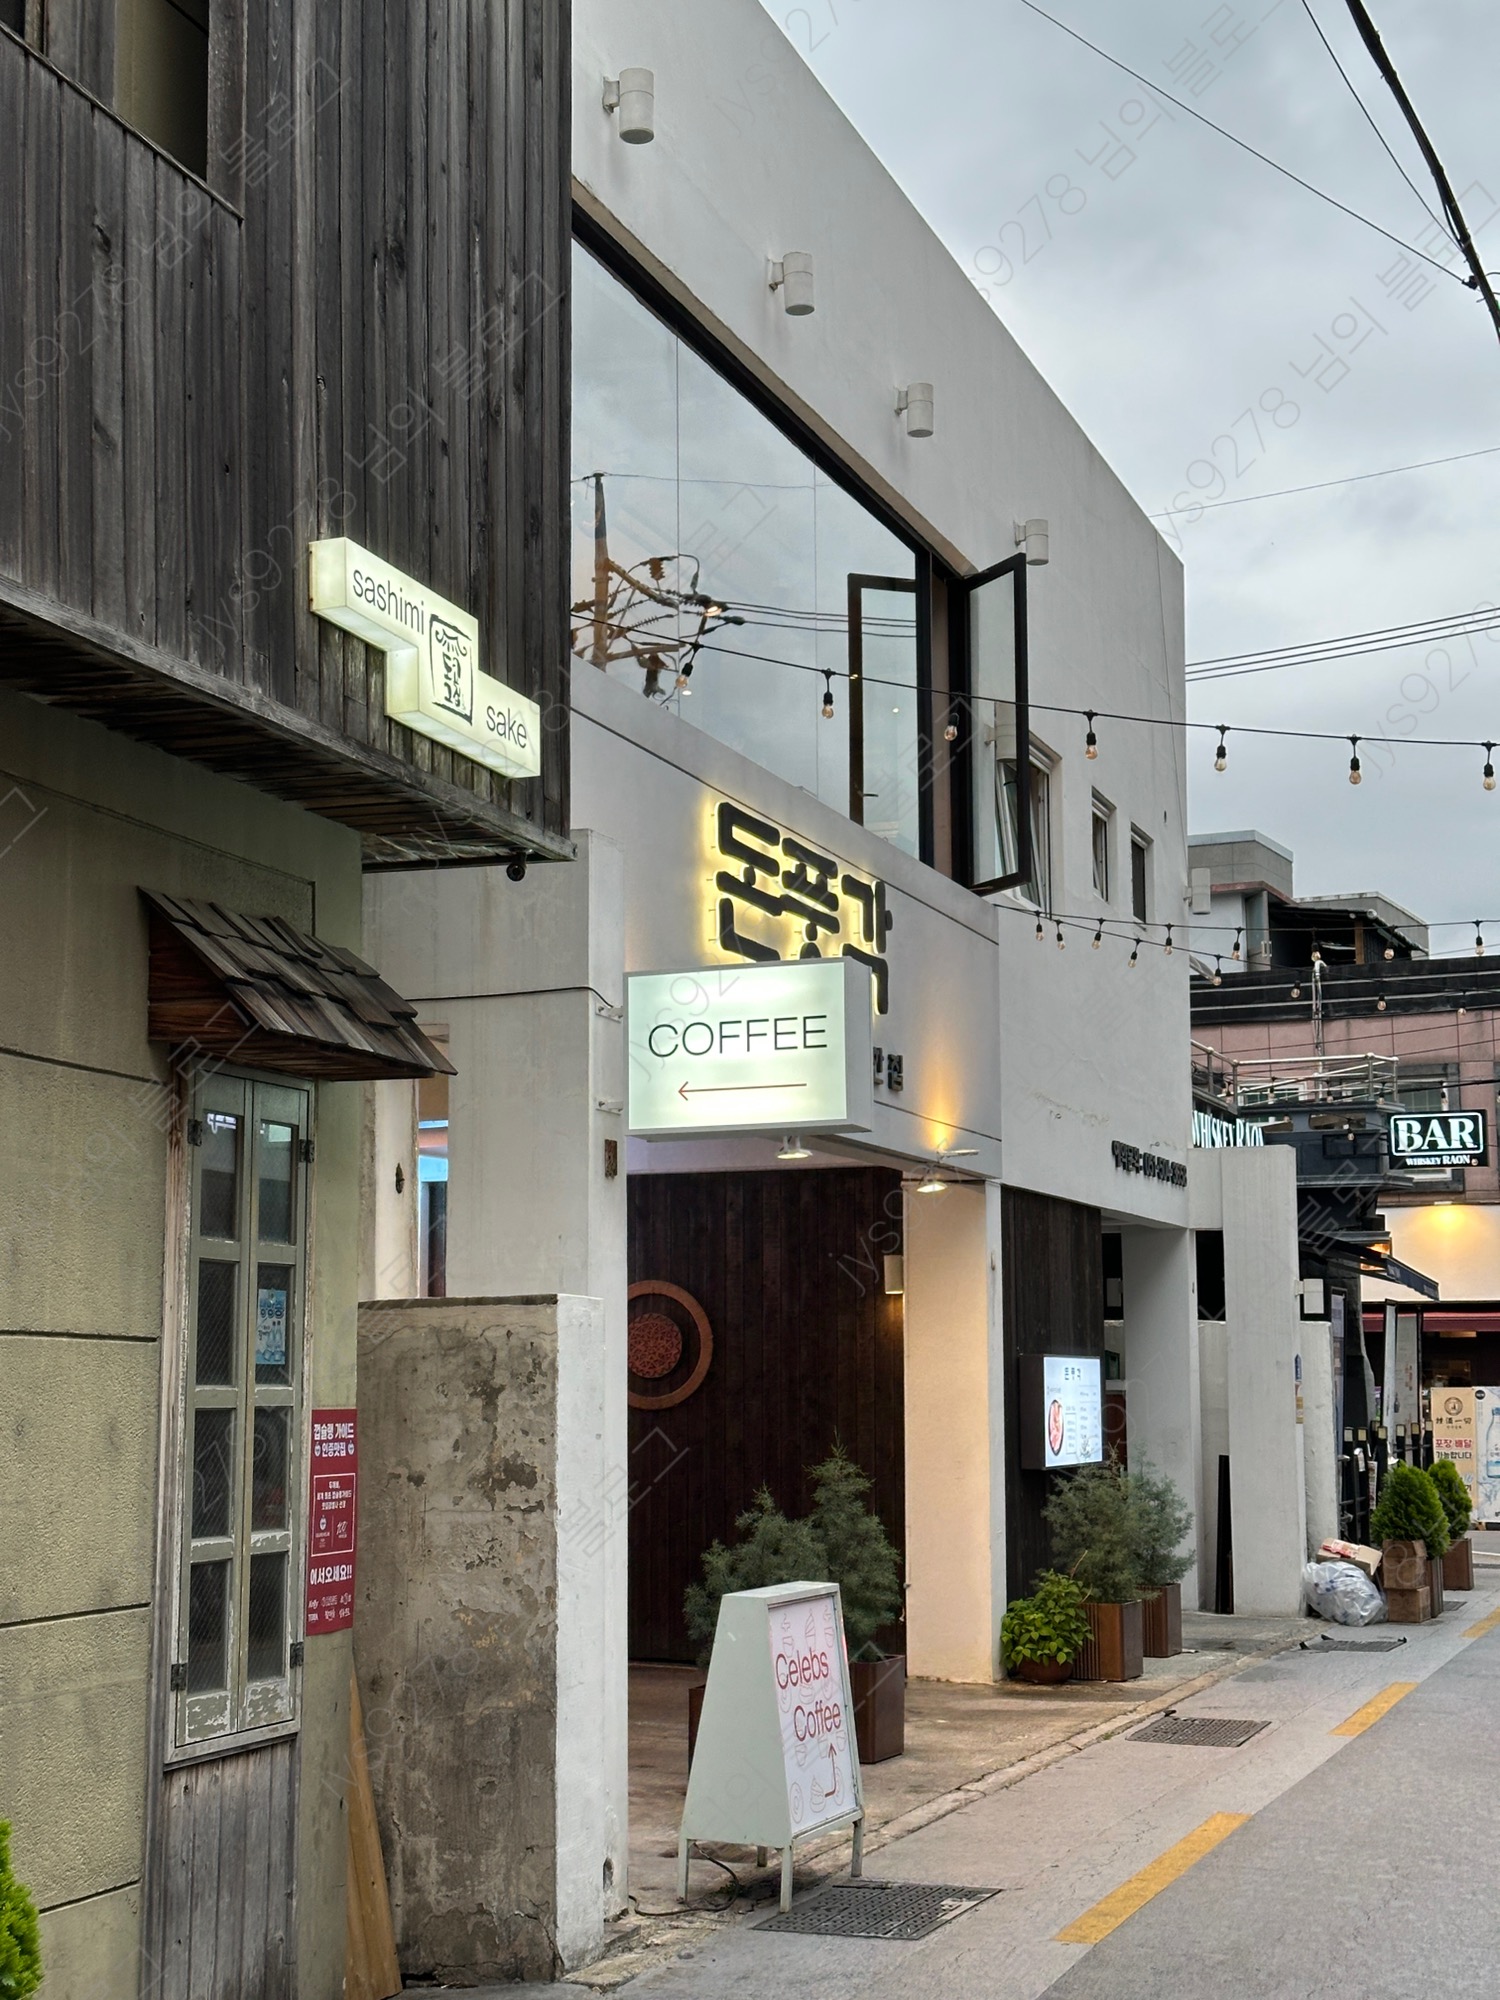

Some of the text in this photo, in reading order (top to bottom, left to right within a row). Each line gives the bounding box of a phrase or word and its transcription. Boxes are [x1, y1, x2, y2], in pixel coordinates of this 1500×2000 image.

[353, 569, 425, 635] sashimi
[486, 705, 528, 749] sake
[648, 1014, 828, 1059] COFFEE
[1396, 1118, 1478, 1152] BAR
[1405, 1155, 1471, 1166] WHISKEY RAON
[334, 1422, 355, 1439] 가이드
[1435, 1439, 1472, 1448] 포장 배달
[321, 1442, 347, 1457] 인증맛집
[1435, 1451, 1472, 1460] 가능합니다
[310, 1564, 353, 1586] 어서오세요!!
[775, 1647, 829, 1690] Celebs
[793, 1699, 842, 1742] Coffee
